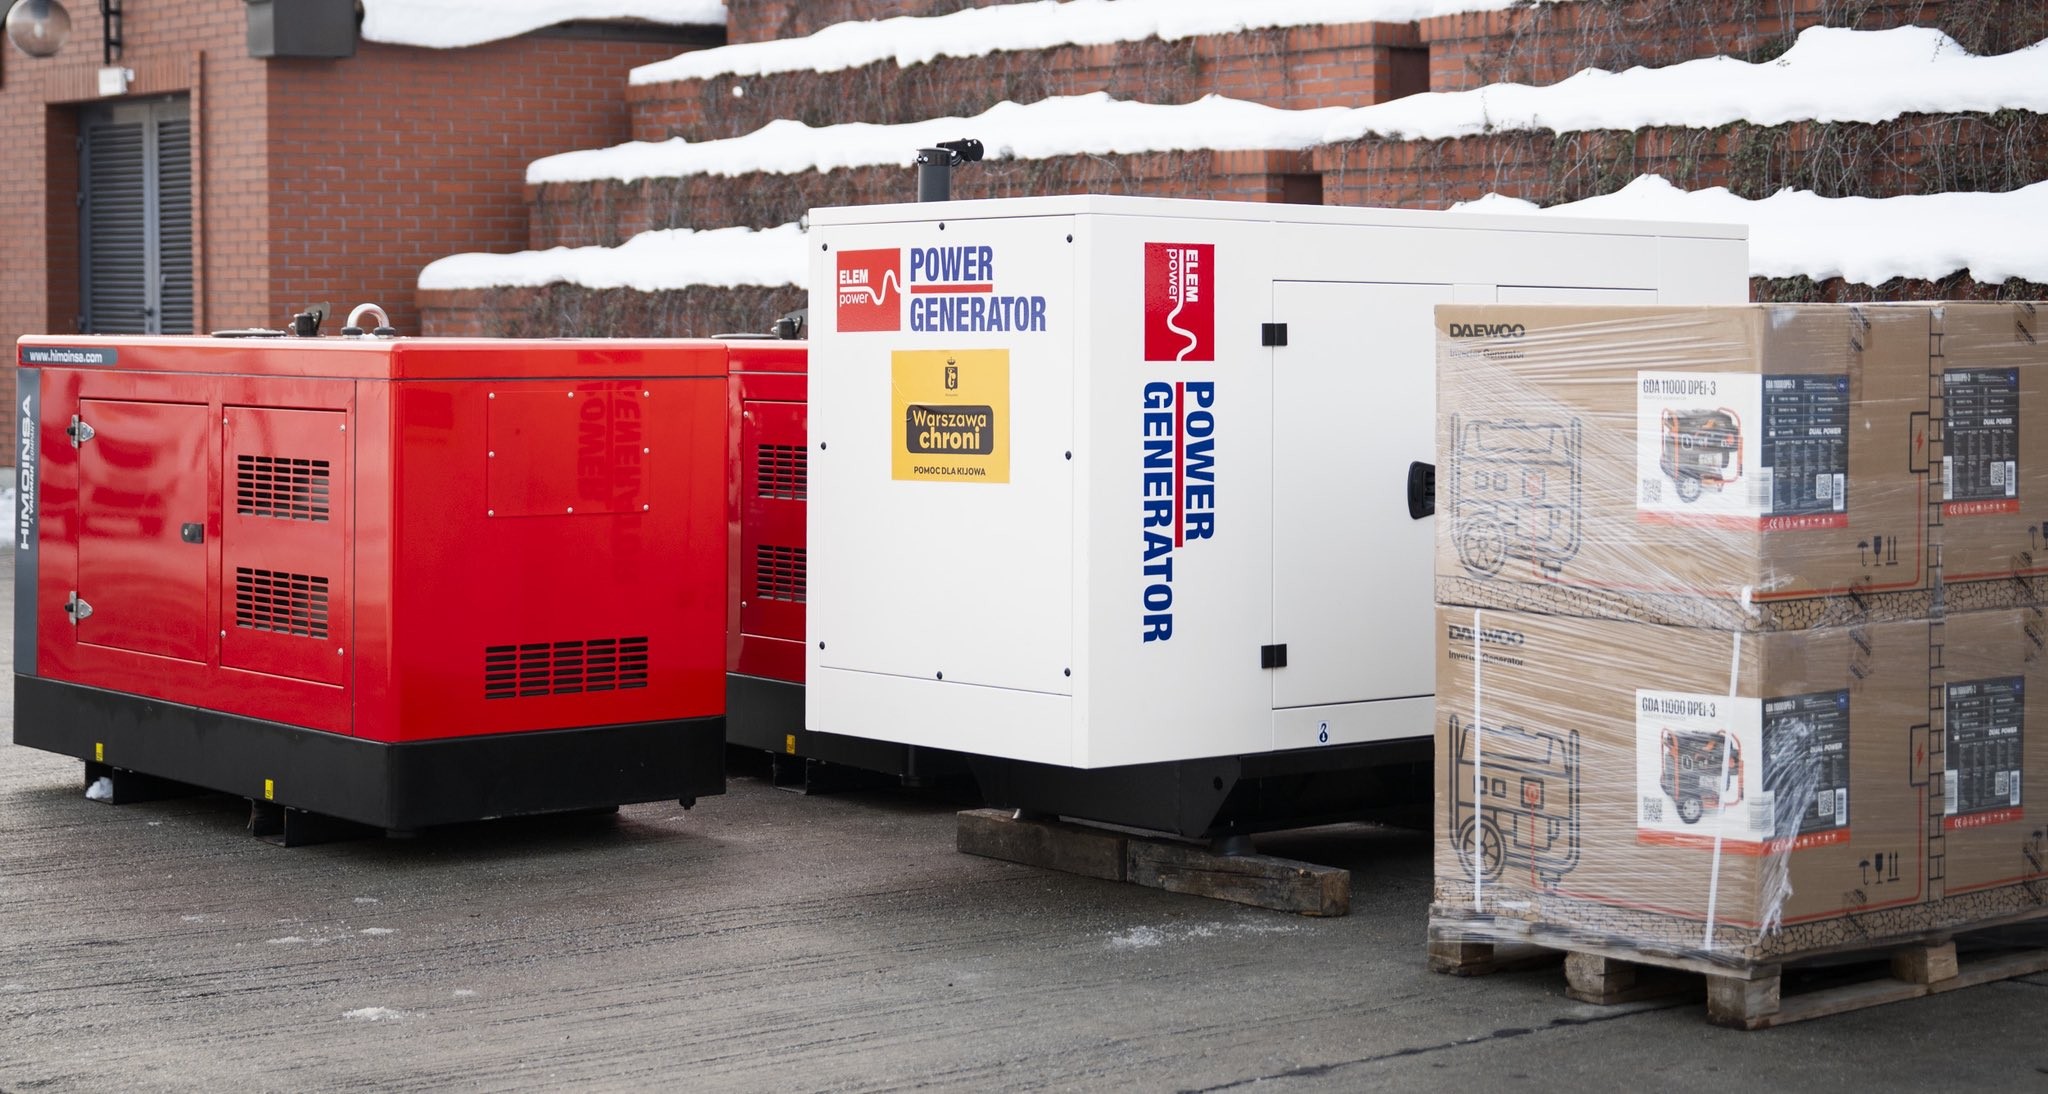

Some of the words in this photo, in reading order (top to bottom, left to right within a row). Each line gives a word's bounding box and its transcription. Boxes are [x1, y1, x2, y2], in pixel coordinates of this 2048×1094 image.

[910, 245, 993, 282] POWER
[840, 269, 869, 284] ELEM
[1166, 248, 1178, 303] power
[1186, 249, 1198, 302] ELEM
[839, 293, 869, 307] power
[910, 295, 1047, 332] GENERATOR
[1449, 323, 1525, 338] DAEWOO
[29, 349, 103, 363] www.himoinsa.com
[1643, 379, 1660, 393] GDA
[1662, 379, 1686, 394] 11000
[912, 409, 987, 427] Warszawa
[919, 426, 980, 449] chroni
[913, 466, 941, 475] POMOC
[941, 467, 956, 475] DLA
[957, 467, 986, 476] KIJOWA
[1185, 381, 1214, 541] POWER
[20, 395, 31, 550] HIMOINSA
[1143, 382, 1173, 643] GENERATOR
[1642, 697, 1659, 712] GDA
[1661, 699, 1686, 715] 11000
